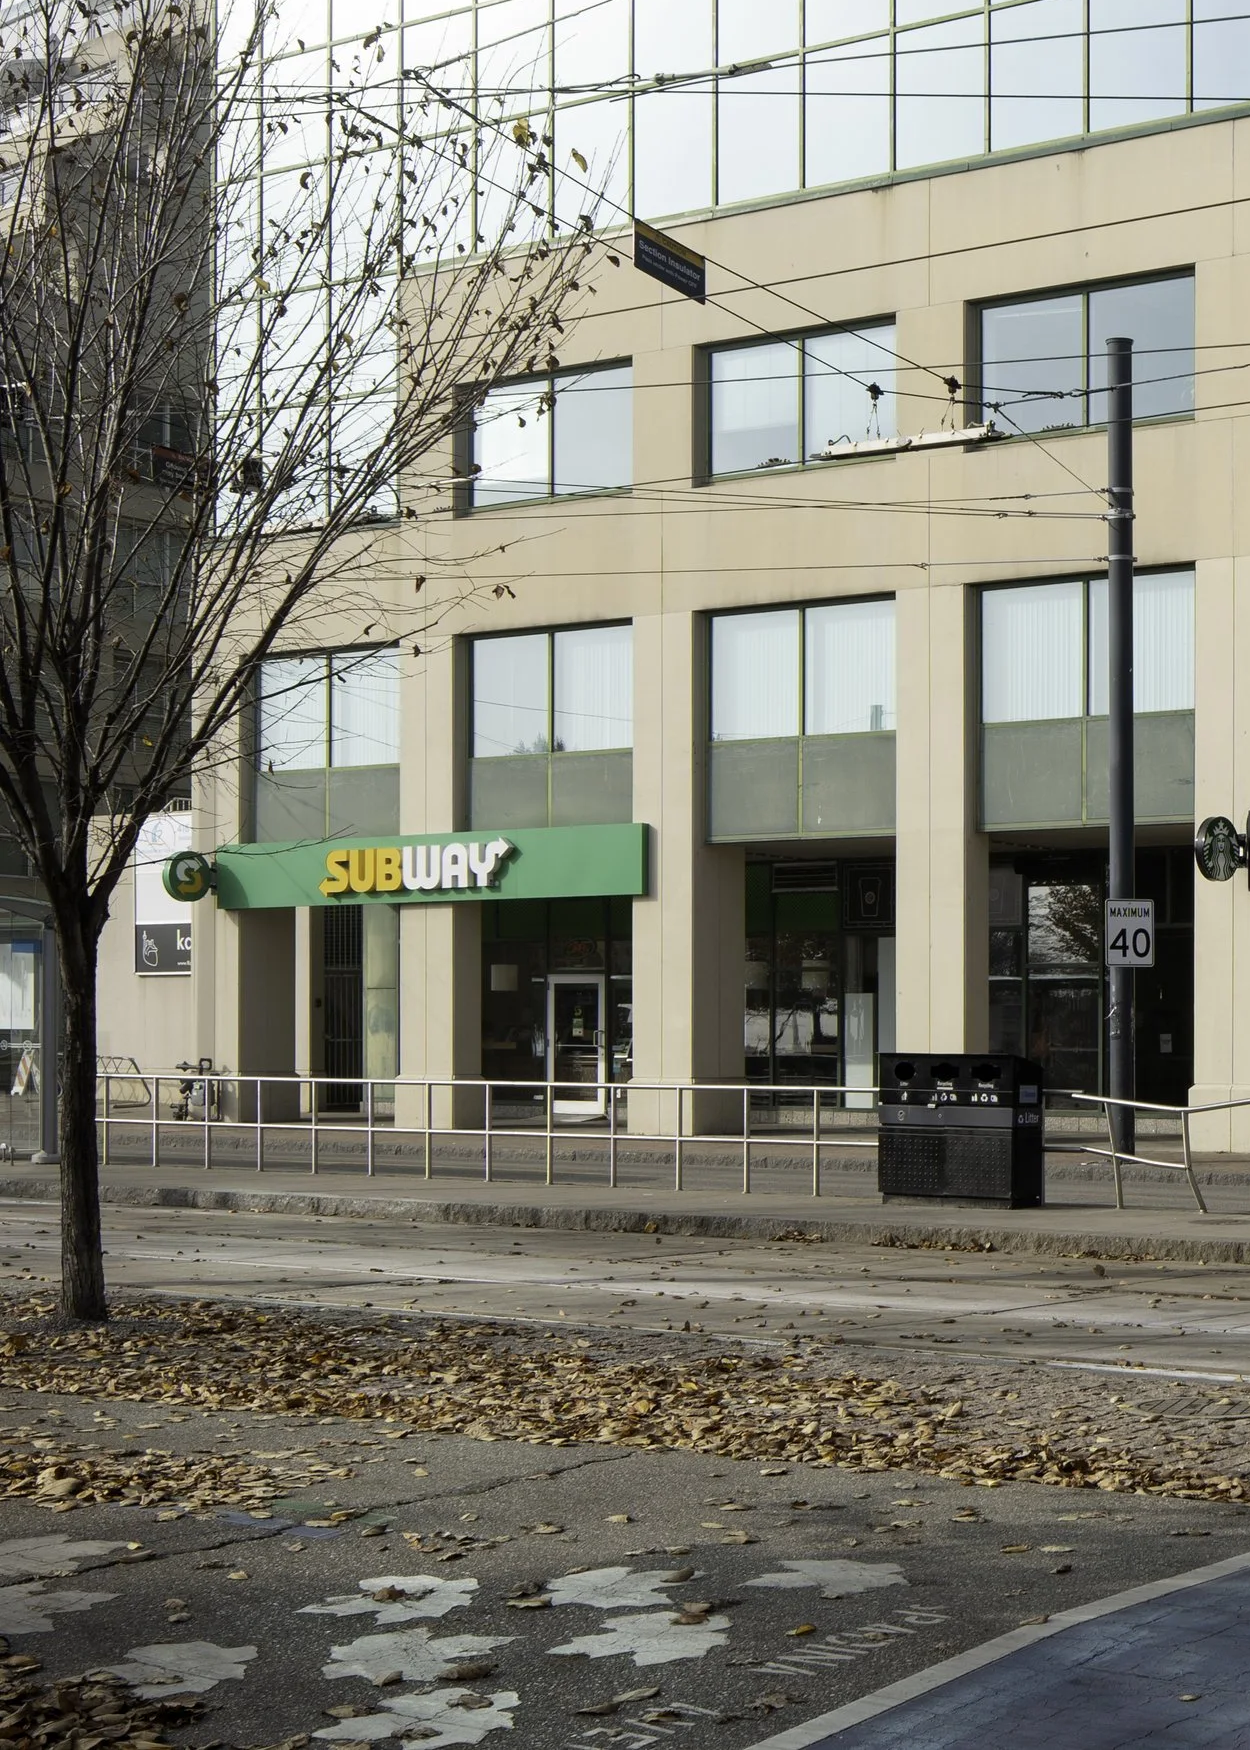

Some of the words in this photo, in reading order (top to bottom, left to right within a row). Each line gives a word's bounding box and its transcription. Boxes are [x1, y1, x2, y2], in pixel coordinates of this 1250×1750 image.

[639, 240, 667, 262] Section
[668, 256, 701, 281] Insulator
[318, 836, 512, 898] SUBWAY
[1109, 906, 1150, 918] MAXIMUM
[1109, 927, 1151, 958] 40
[1025, 1112, 1039, 1124] Litter
